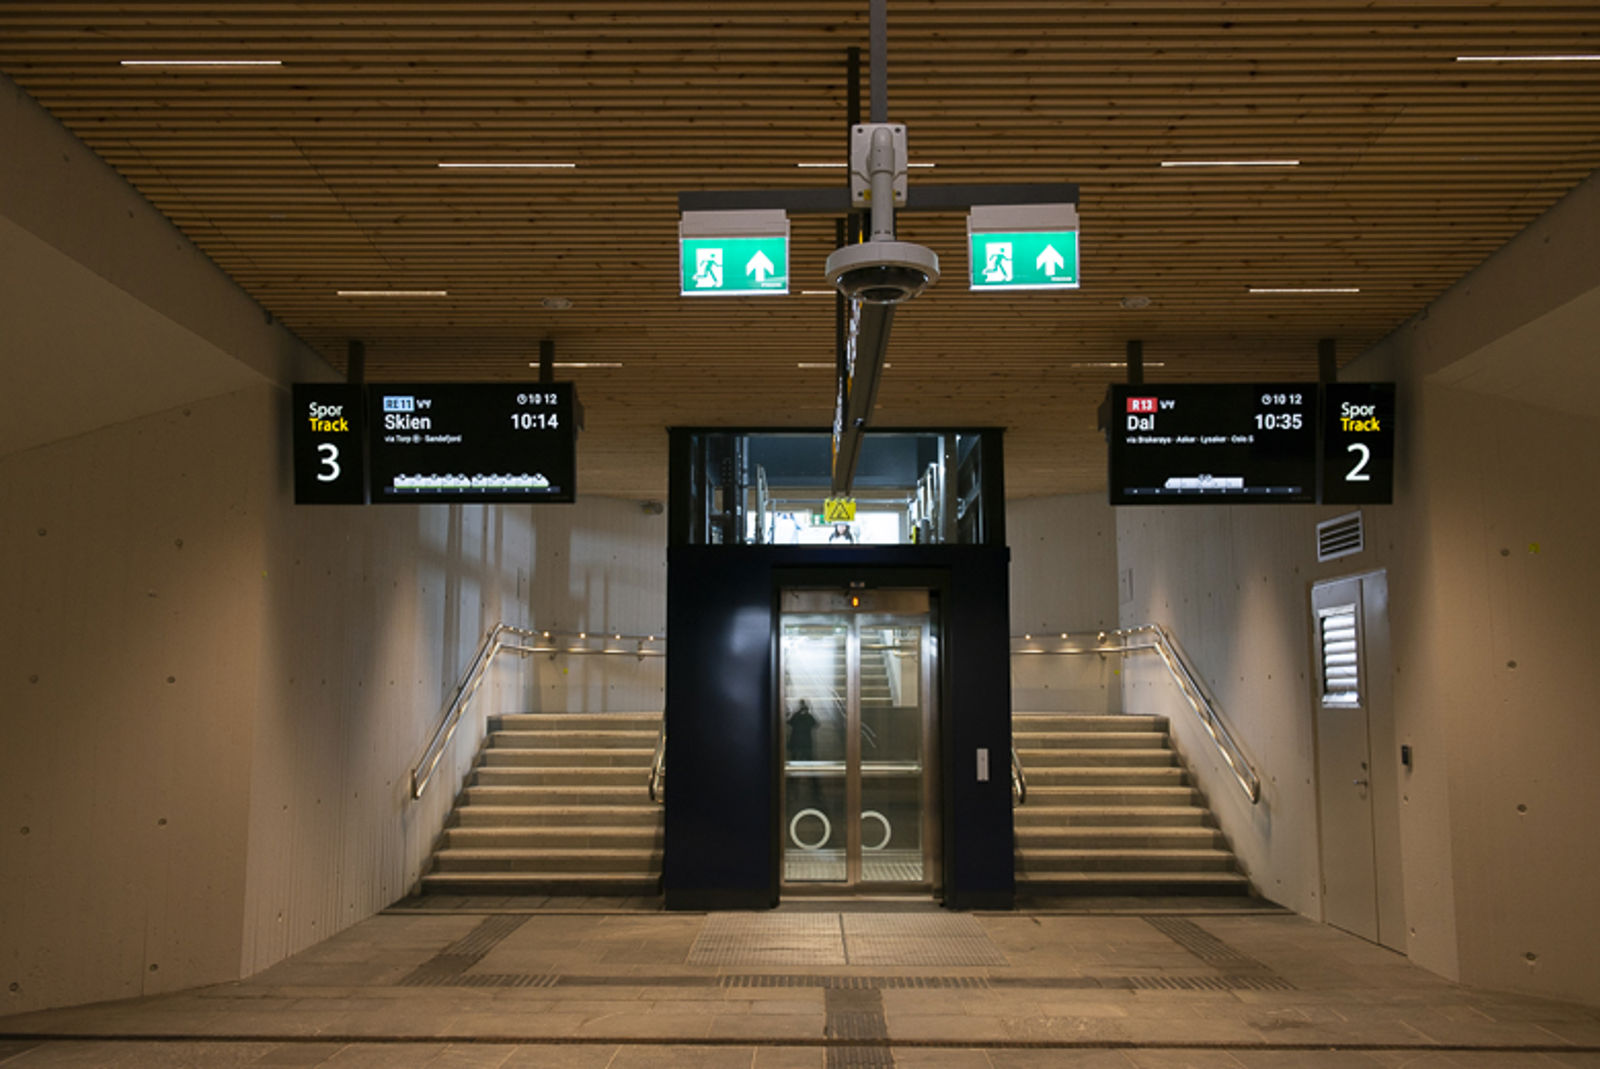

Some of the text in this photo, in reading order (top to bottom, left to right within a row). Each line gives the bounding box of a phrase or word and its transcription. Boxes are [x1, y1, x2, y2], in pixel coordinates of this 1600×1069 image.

[309, 401, 344, 420] Spor
[386, 399, 413, 409] RE11
[1132, 399, 1153, 411] R13
[1341, 401, 1376, 420] Spor
[308, 416, 349, 432] Track
[384, 413, 432, 430] Skien
[510, 413, 559, 430] 10:14
[1127, 414, 1155, 431] Dal
[1255, 413, 1303, 430] 10:35
[1340, 416, 1381, 432] Track
[317, 442, 341, 482] 3
[1345, 442, 1370, 482] 2
